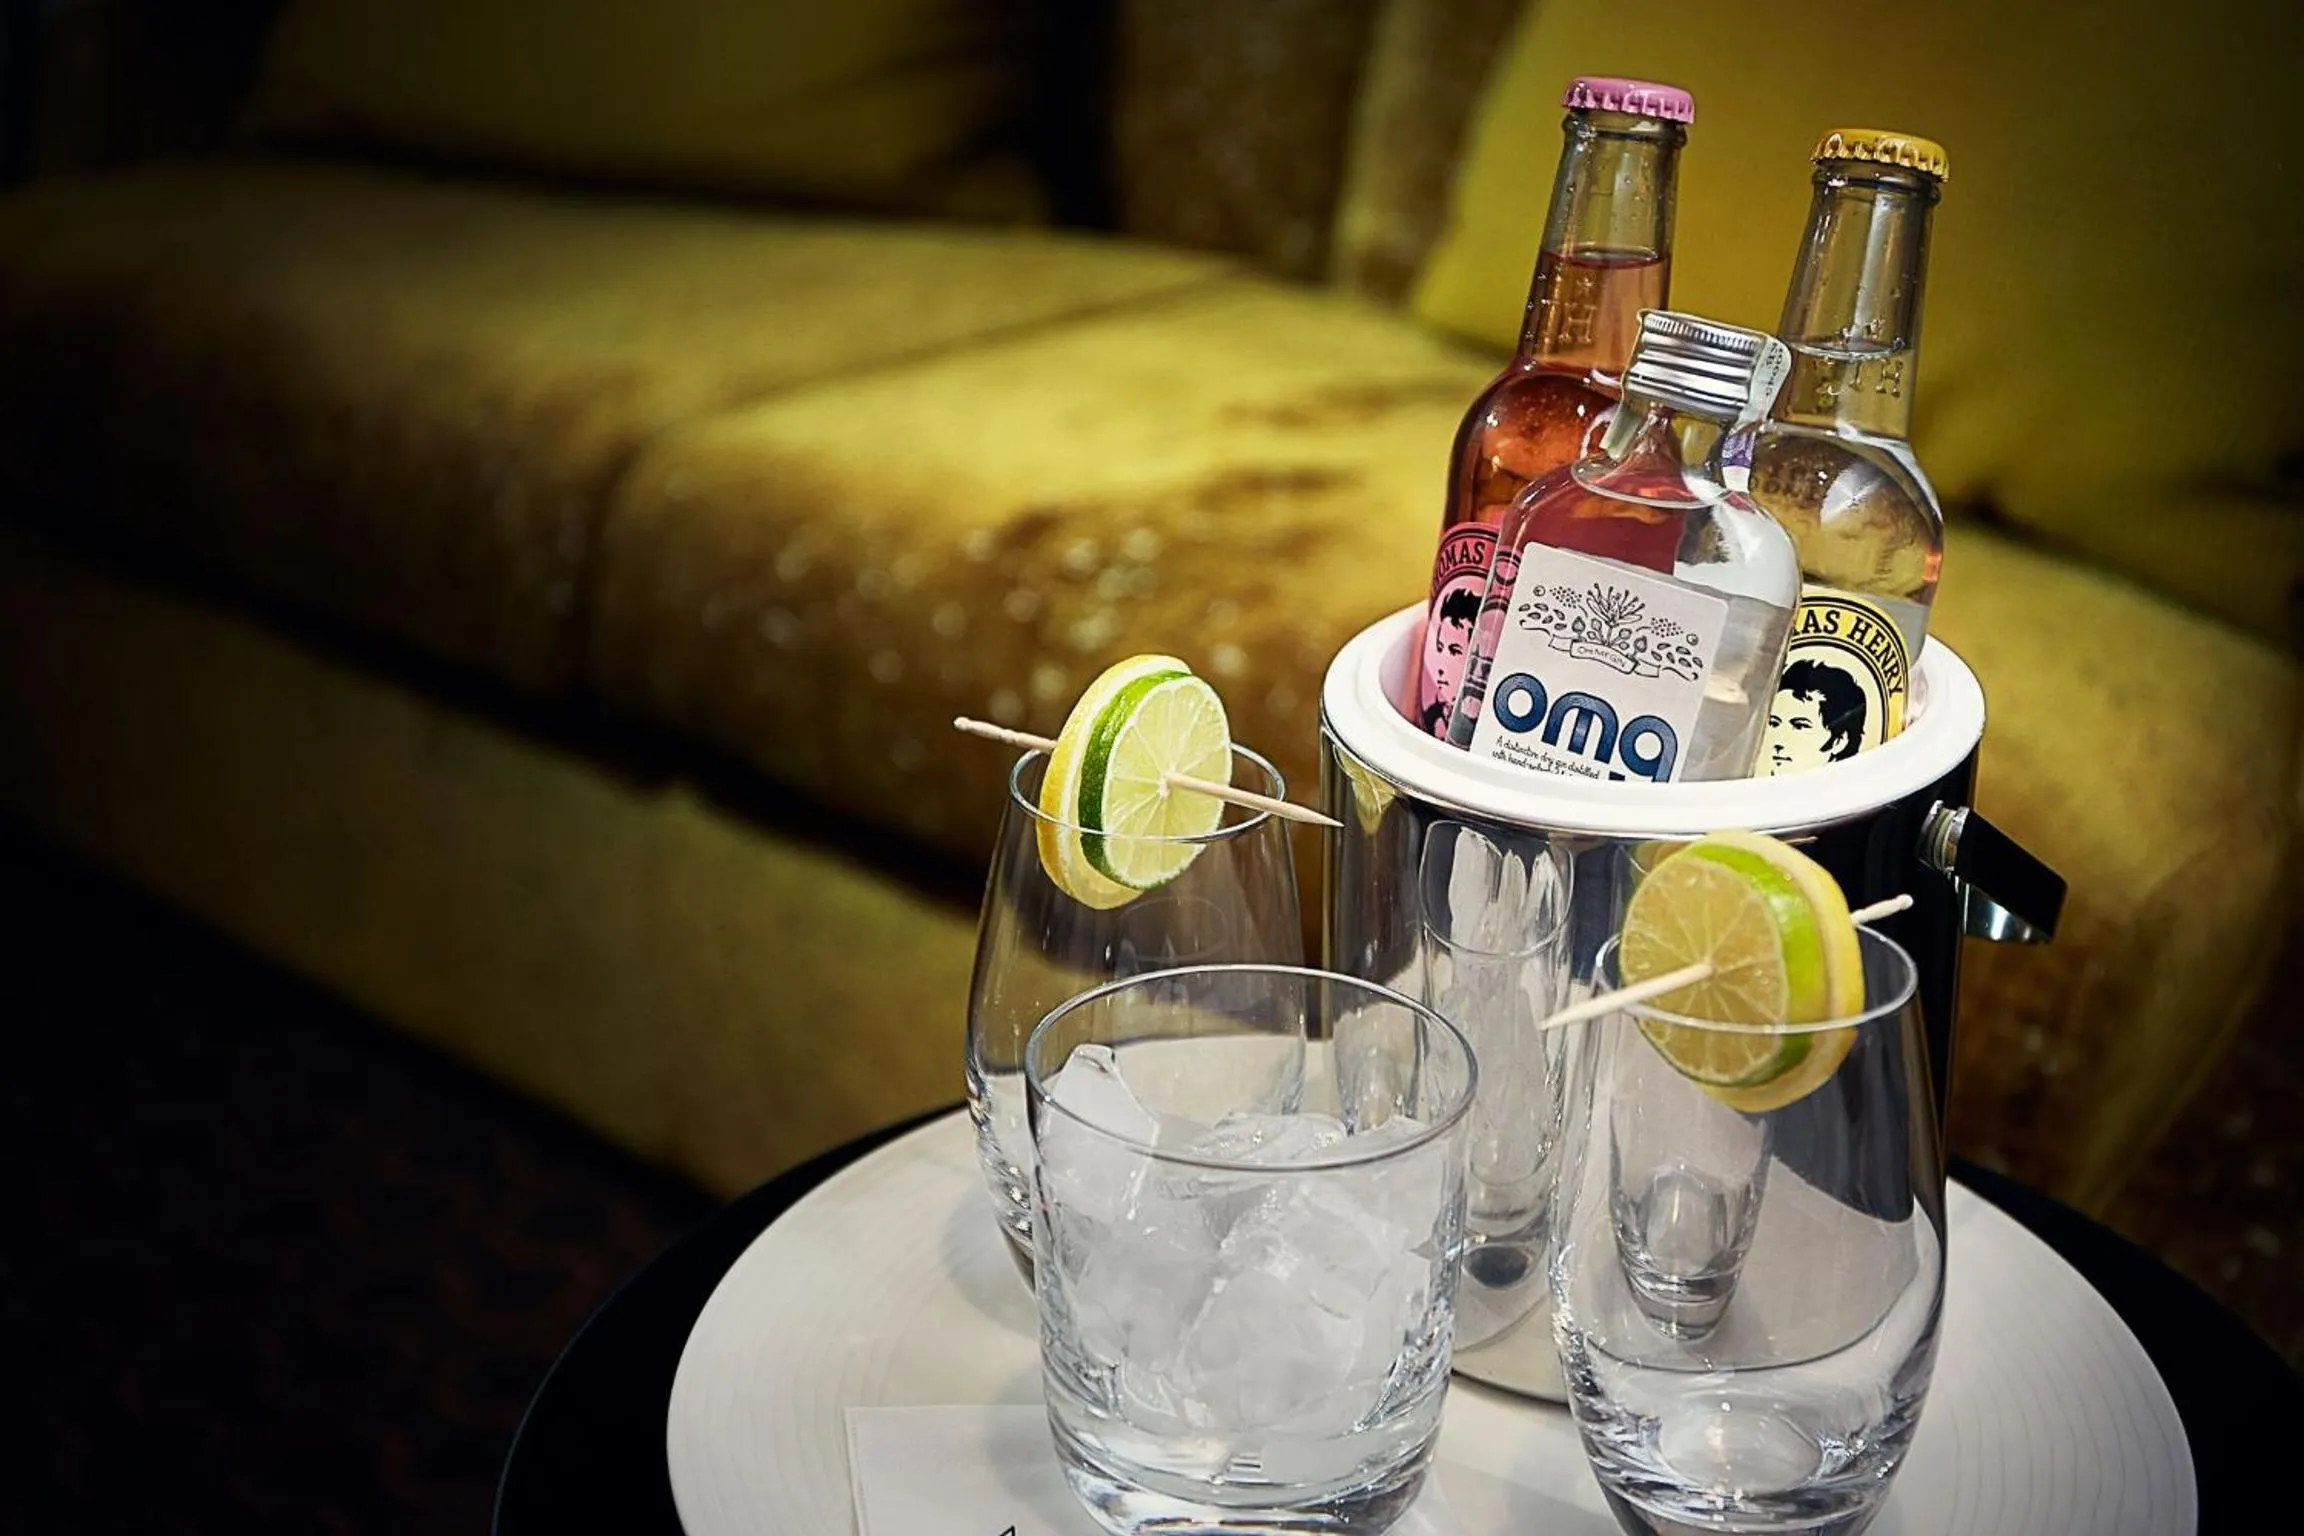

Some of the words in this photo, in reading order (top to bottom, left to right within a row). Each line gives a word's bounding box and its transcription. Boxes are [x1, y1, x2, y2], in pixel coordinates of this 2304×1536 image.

[1435, 541, 1485, 584] OMAS
[1793, 609, 1841, 635] AS
[1846, 618, 1903, 698] HENRY
